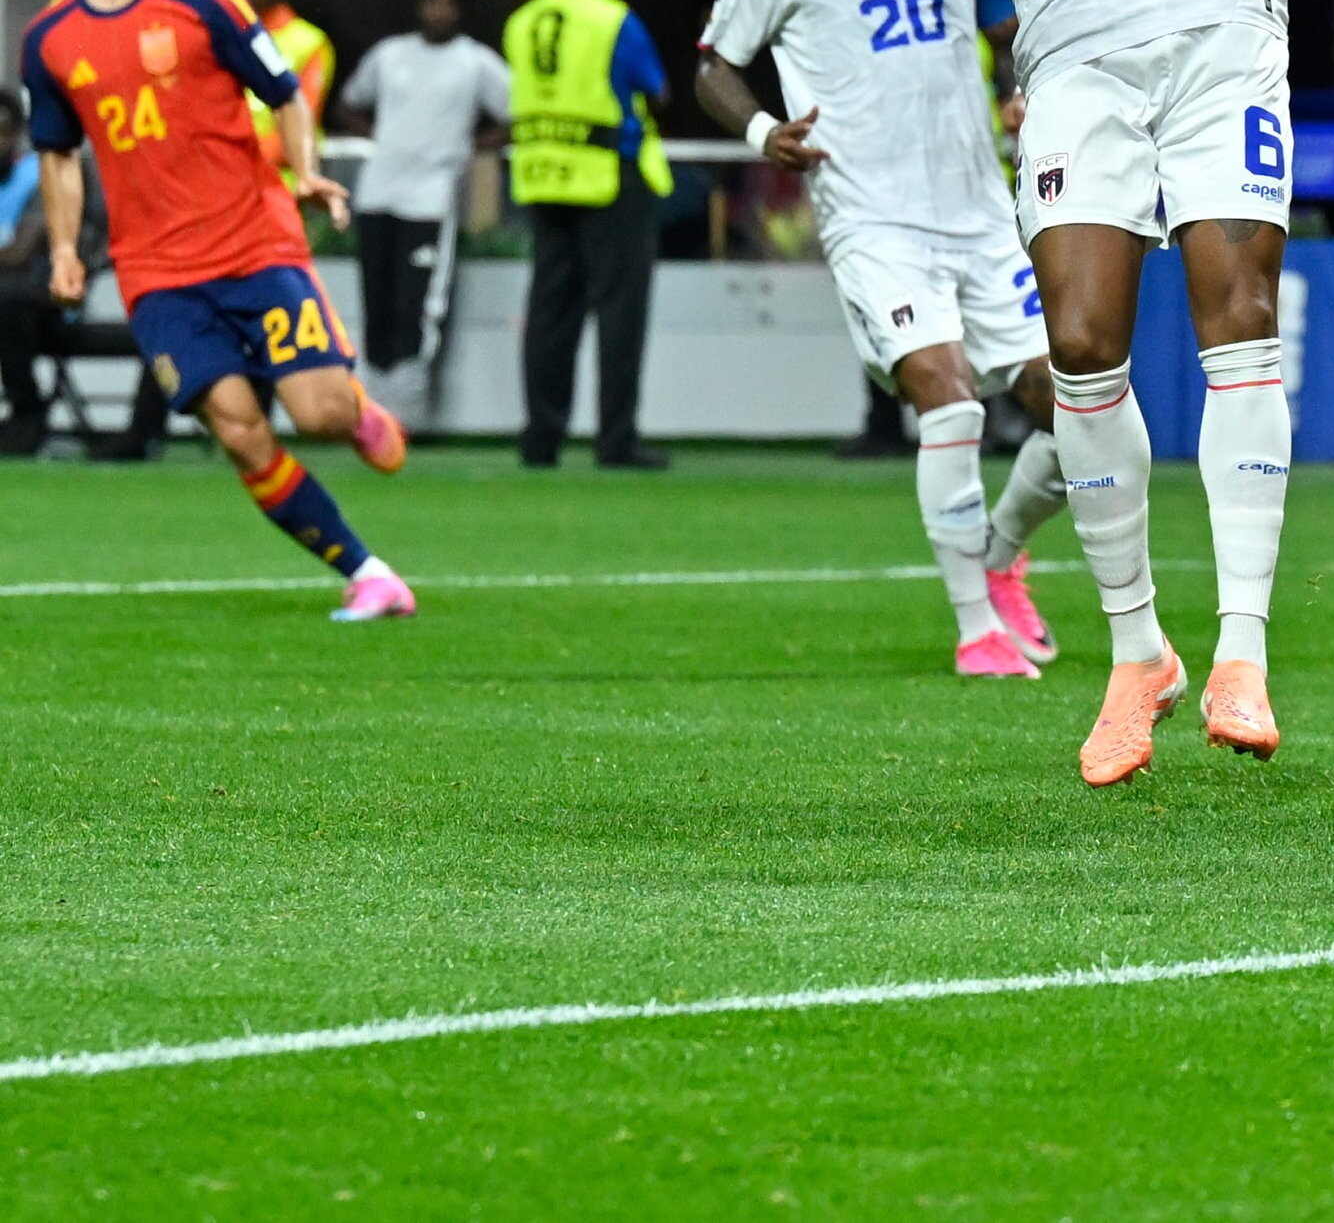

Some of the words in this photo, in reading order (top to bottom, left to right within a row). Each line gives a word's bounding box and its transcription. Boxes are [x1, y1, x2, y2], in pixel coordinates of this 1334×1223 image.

[97, 84, 168, 153] 24
[1244, 105, 1285, 180] 6
[262, 297, 331, 365] 24
